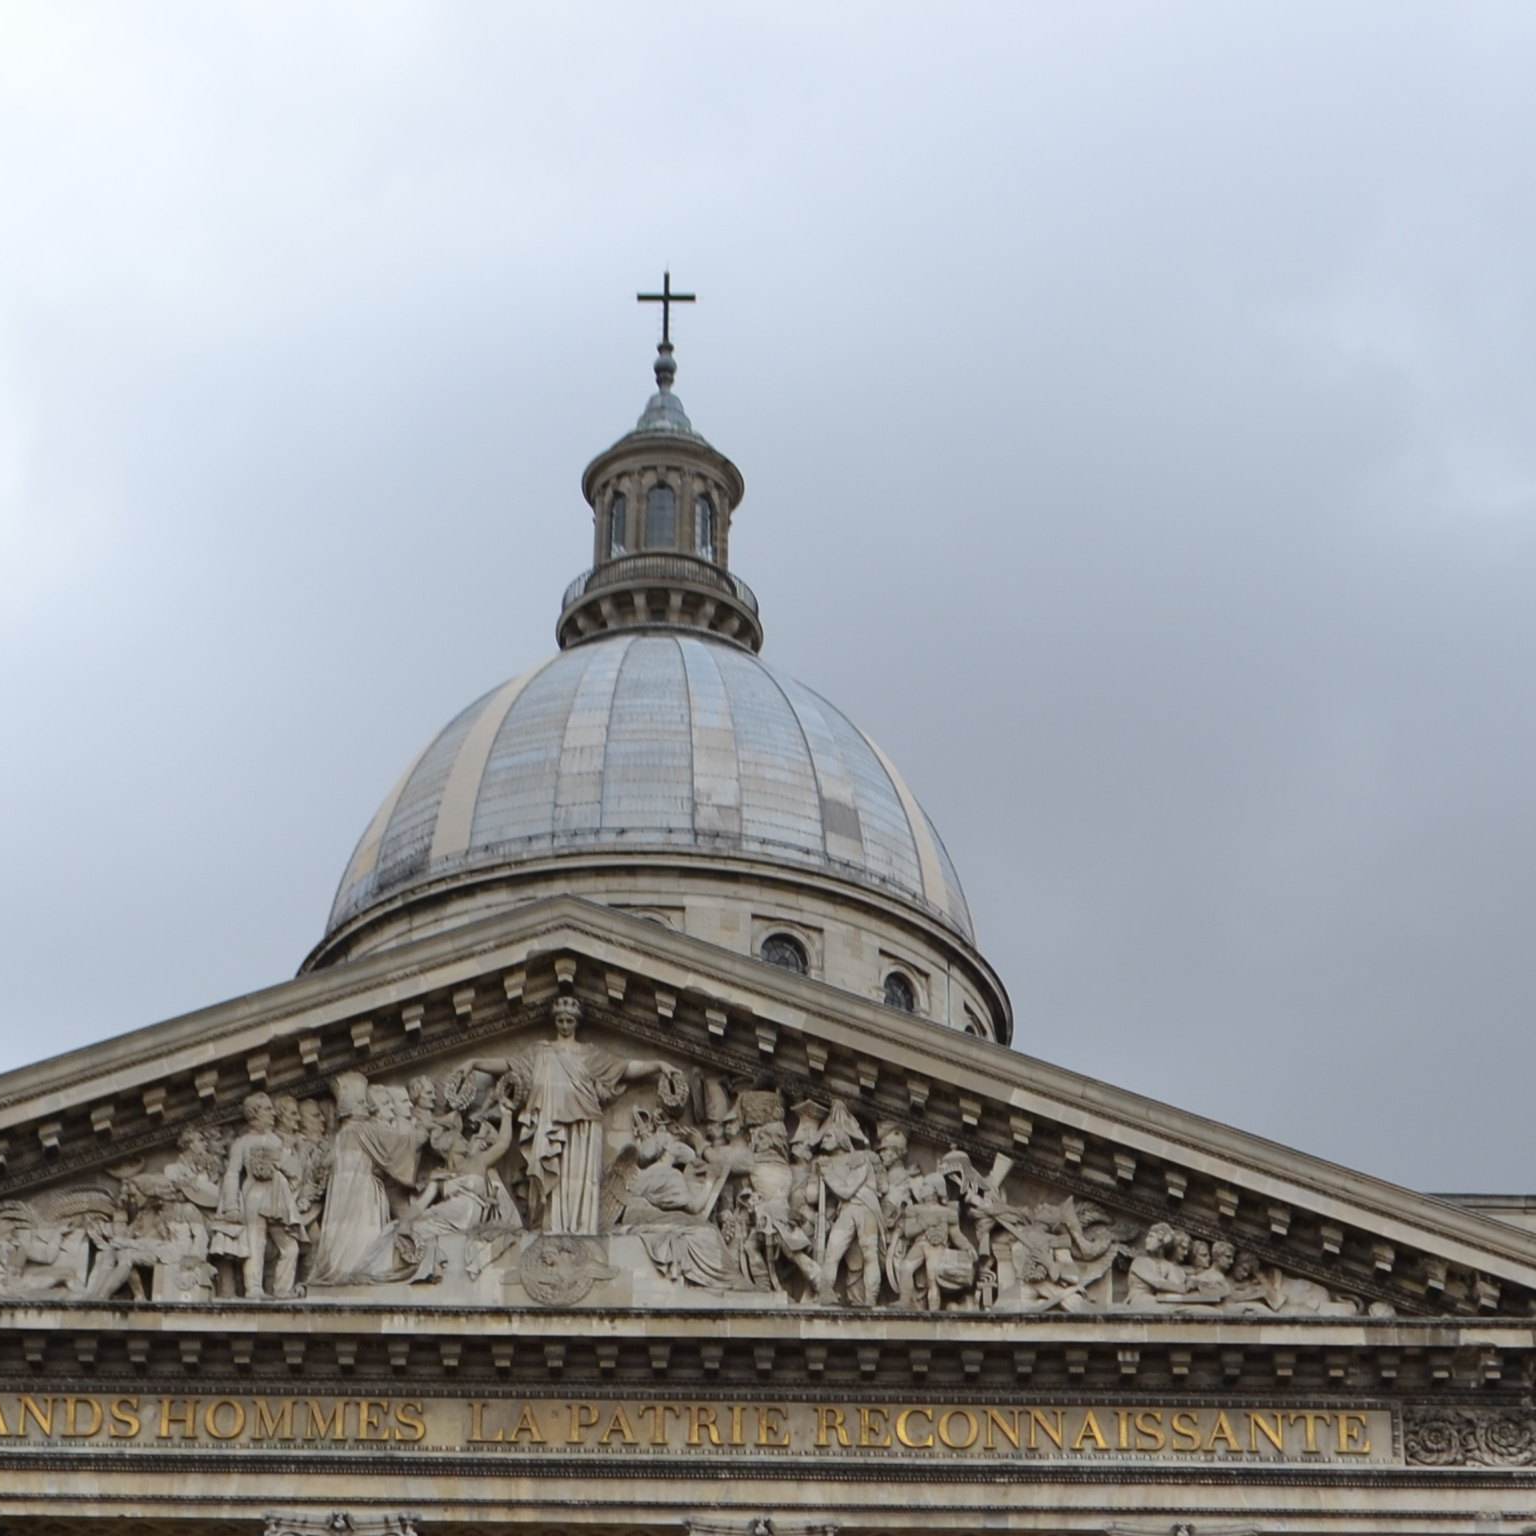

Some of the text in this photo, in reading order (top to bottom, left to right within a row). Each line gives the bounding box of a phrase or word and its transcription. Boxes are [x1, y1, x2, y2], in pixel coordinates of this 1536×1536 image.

[155, 1398, 427, 1443] HOMMES
[465, 1400, 547, 1444] LA
[565, 1402, 790, 1448] PATRIE
[812, 1405, 1371, 1454] RECONNAISSANTE
